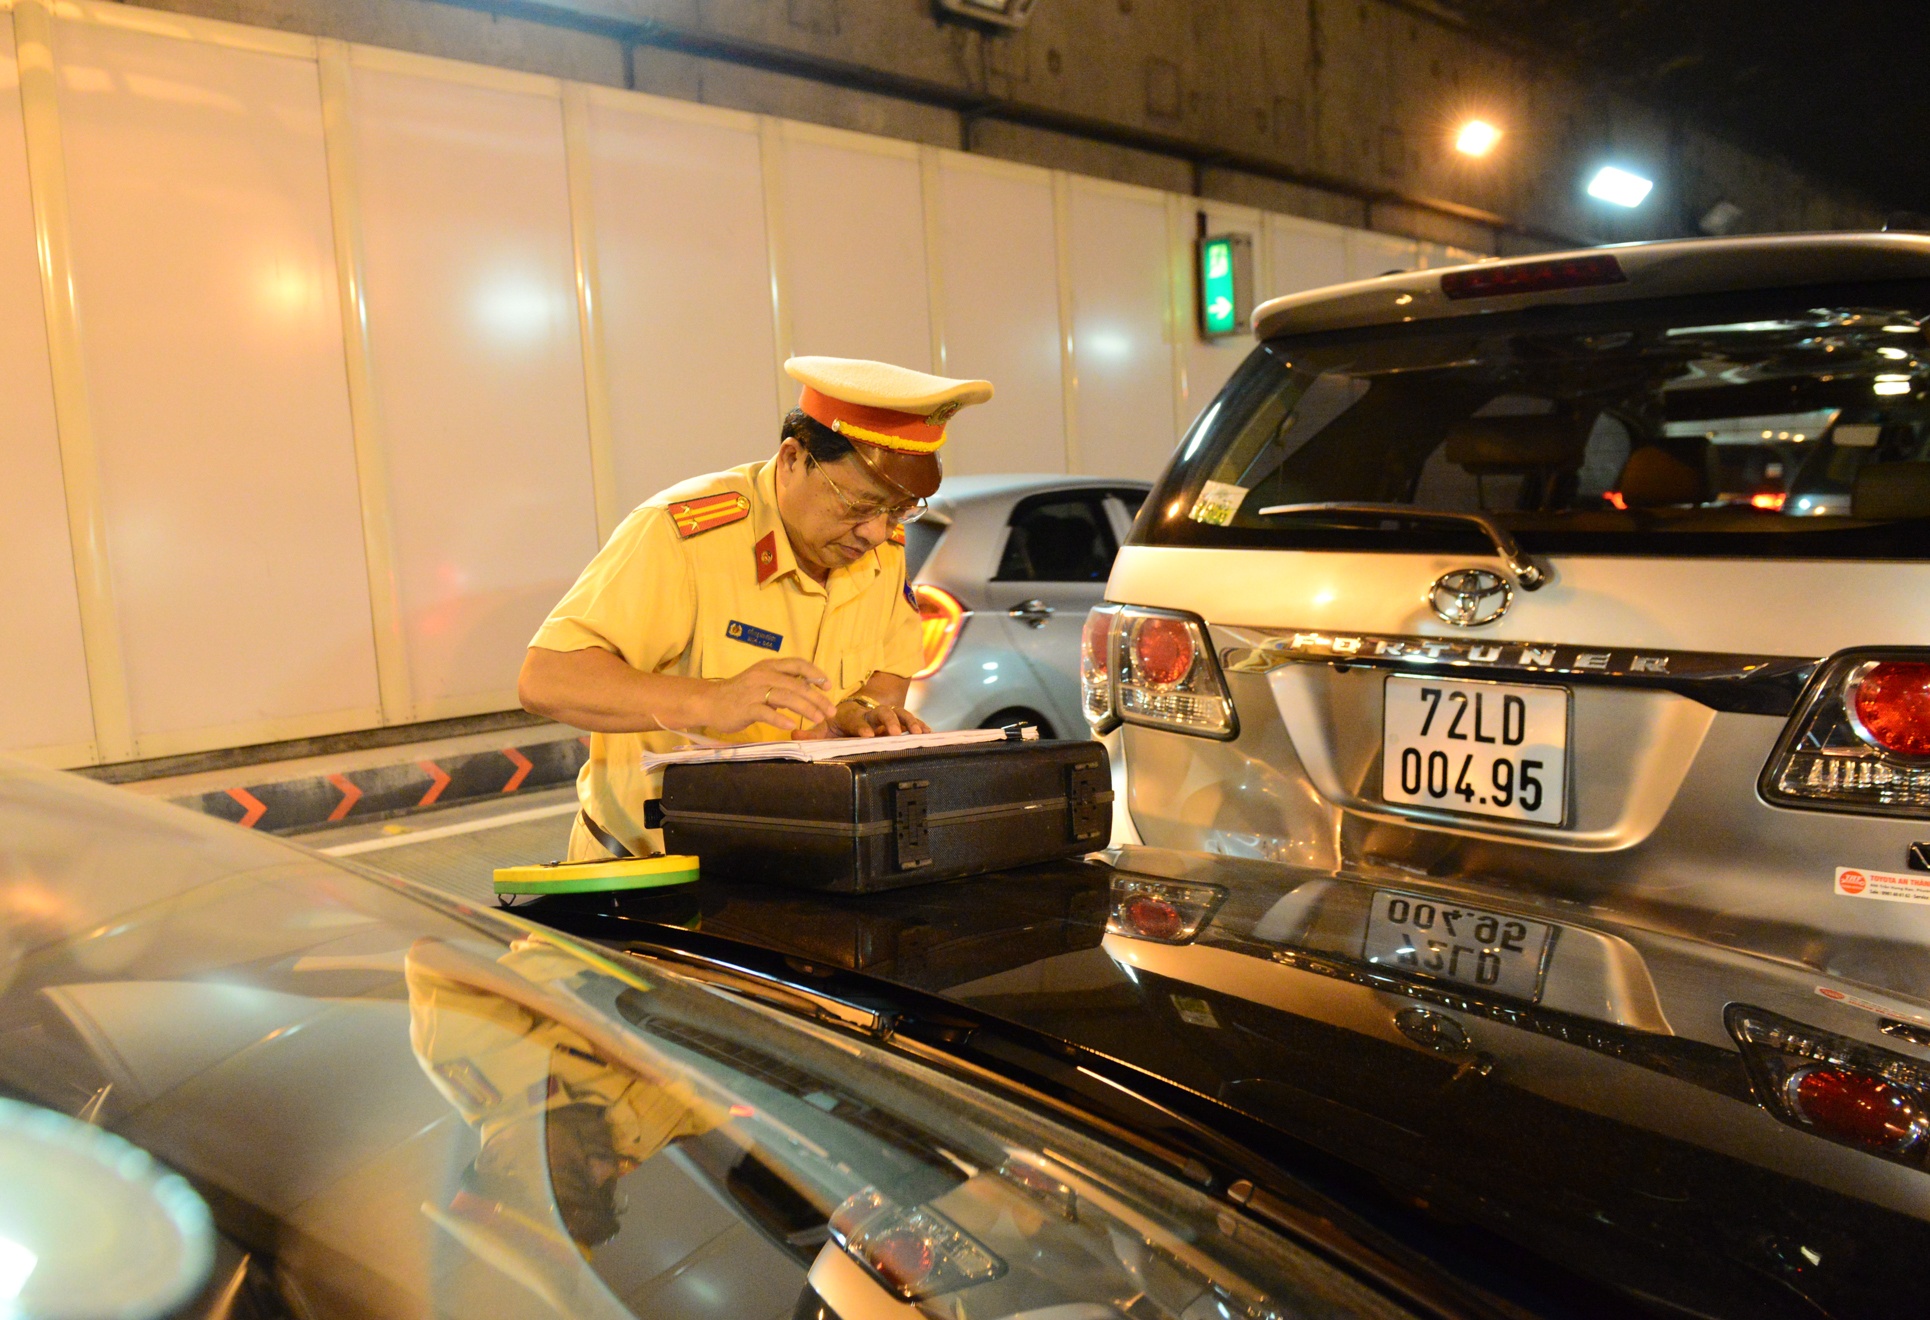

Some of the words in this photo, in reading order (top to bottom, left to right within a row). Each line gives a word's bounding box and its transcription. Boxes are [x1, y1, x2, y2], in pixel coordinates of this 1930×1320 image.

[1290, 632, 1671, 675] FORTUNER
[1420, 687, 1526, 746] 72LD
[1401, 747, 1543, 812] 004.95
[1871, 875, 1896, 883] TOYOTA
